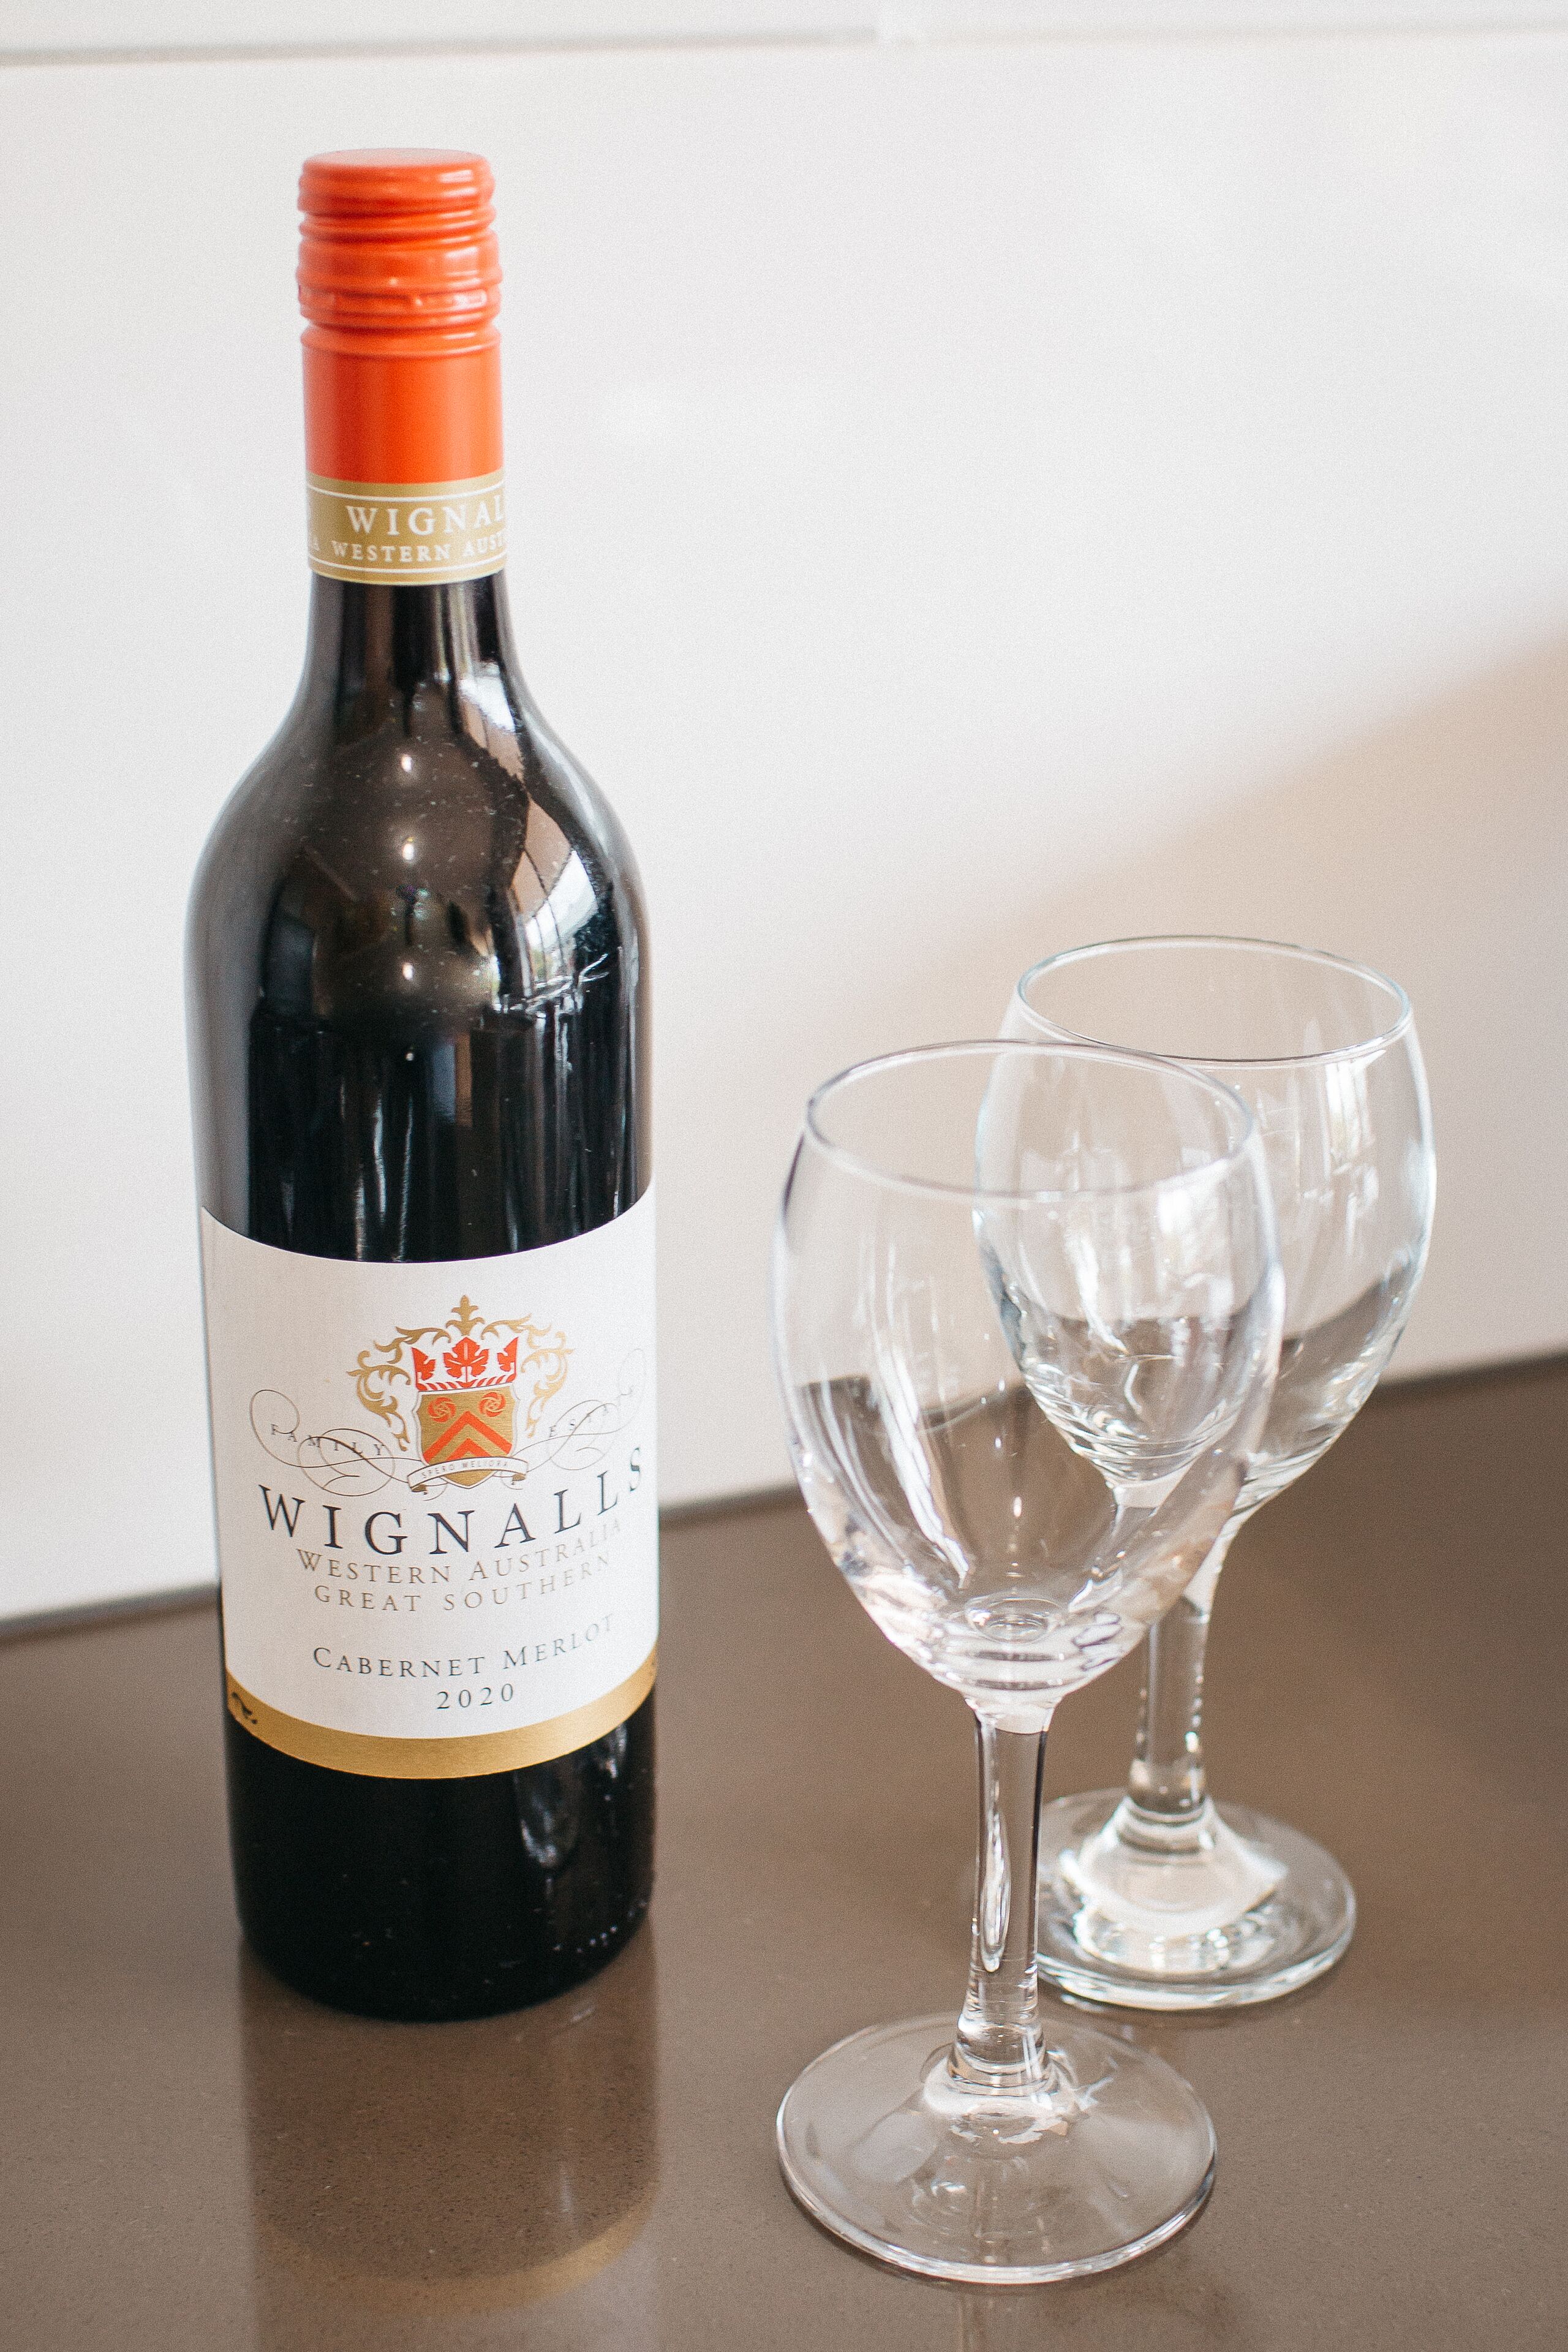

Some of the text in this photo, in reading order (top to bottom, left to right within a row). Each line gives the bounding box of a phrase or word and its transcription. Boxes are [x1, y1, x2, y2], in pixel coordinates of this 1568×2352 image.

[331, 540, 452, 564] WESTERN
[271, 1423, 385, 1455] FAMILY
[258, 1447, 641, 1555] WIGNALLS
[296, 1518, 621, 1584] WESTERN AUSTRALIA
[314, 1551, 610, 1611] GREAT SOUTHERN
[312, 1646, 486, 1678] CABERNET
[436, 1683, 514, 1709] 2020
